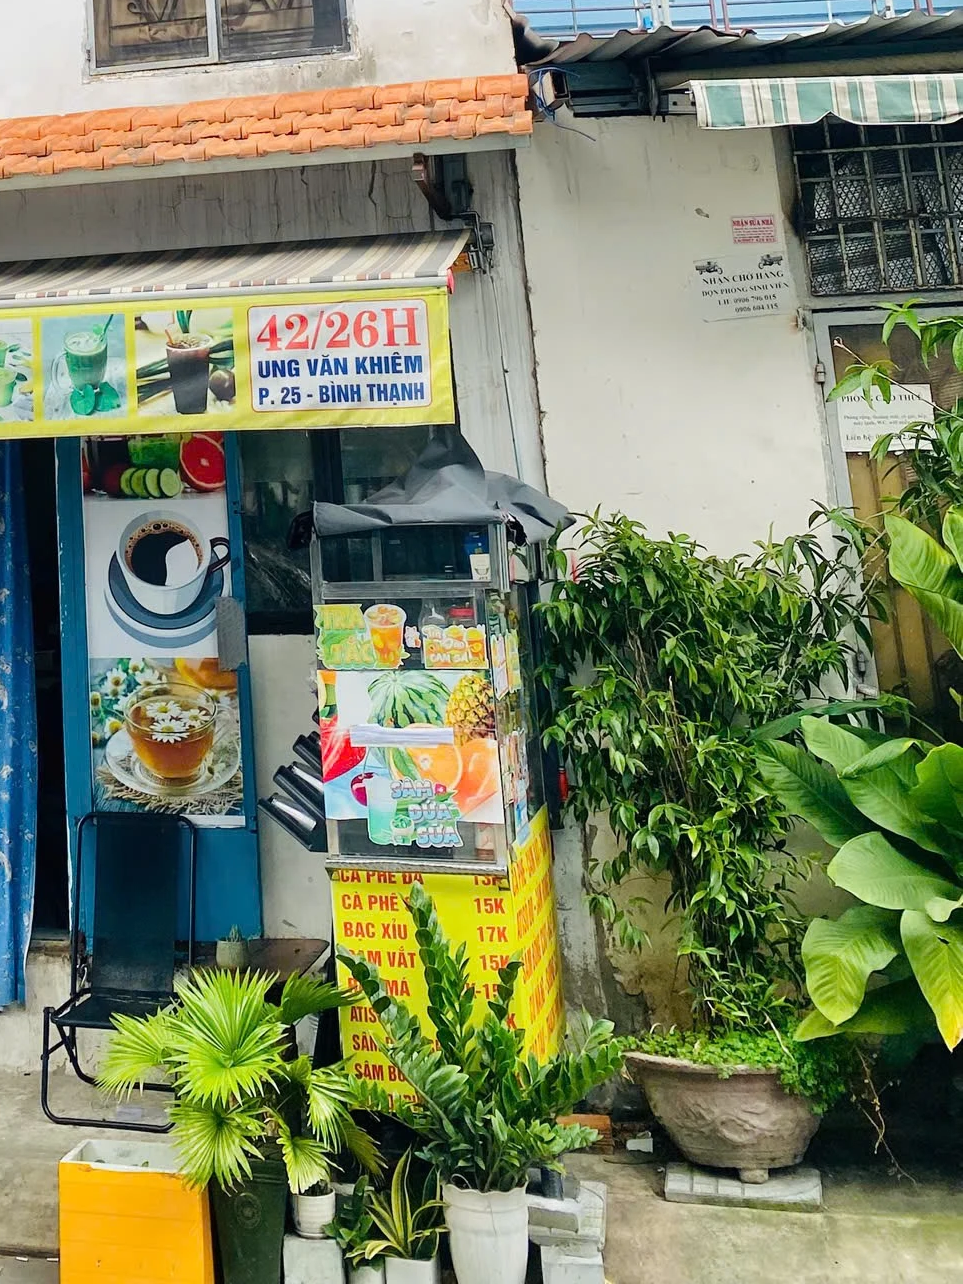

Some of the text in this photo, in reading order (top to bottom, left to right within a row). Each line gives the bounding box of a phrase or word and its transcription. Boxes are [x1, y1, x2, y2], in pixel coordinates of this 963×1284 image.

[256, 307, 421, 351] 42/26H
[257, 351, 423, 378] UNG VĂN KHIÊM
[319, 380, 361, 403] BÌNH
[366, 381, 425, 406] THẠNH
[341, 890, 364, 911] CÀ
[367, 892, 399, 912] PHÊ
[473, 897, 506, 914] 15K
[343, 918, 509, 943] BẠC XỈU 17K
[386, 945, 416, 969] VẮT
[350, 1005, 377, 1023] ATIS
[354, 1060, 384, 1082] SÂM
